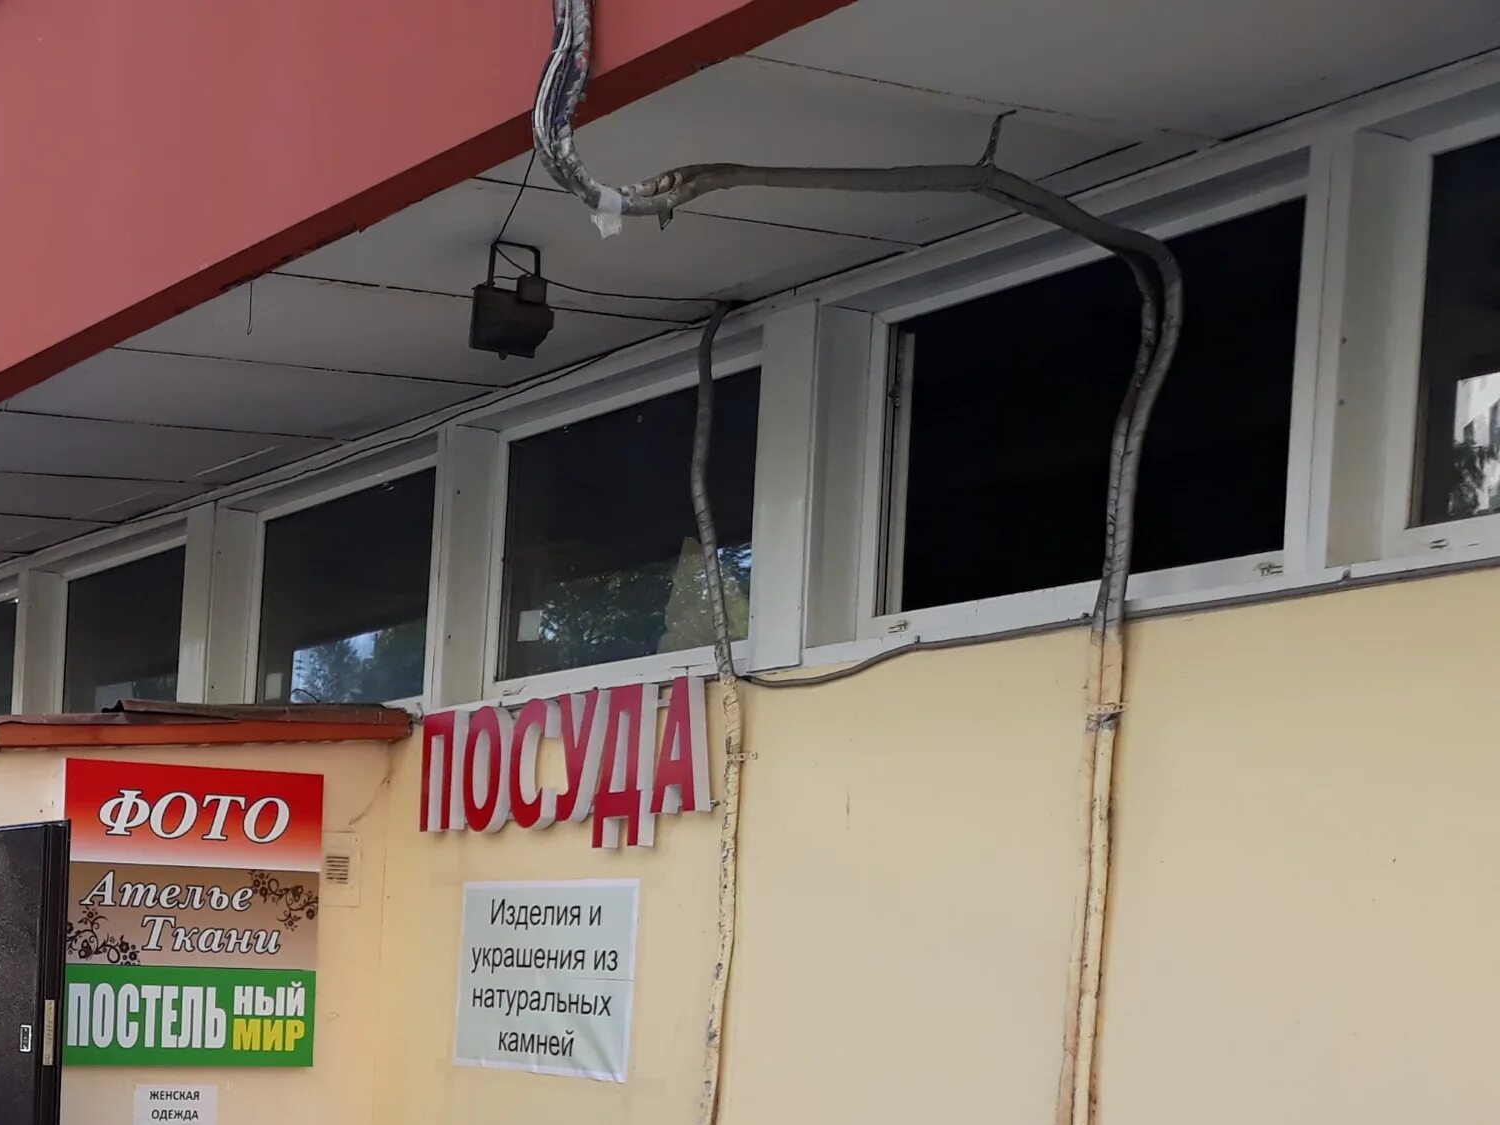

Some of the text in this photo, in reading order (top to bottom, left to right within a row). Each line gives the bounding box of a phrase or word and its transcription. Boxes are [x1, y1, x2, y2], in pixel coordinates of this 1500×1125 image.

[419, 676, 708, 848] ПОСУДА
[98, 788, 291, 844] ФОТО
[79, 870, 254, 913] Ателье
[490, 898, 602, 928] Изделия и
[140, 914, 282, 955] Ткани
[471, 944, 618, 974] украшения из
[472, 985, 612, 1017] натуральных
[232, 1018, 305, 1052] МИР
[498, 1028, 575, 1058] камней
[149, 1090, 200, 1101] ЖЕНСКАЯ
[151, 1109, 199, 1122] ОДЕЖДА
